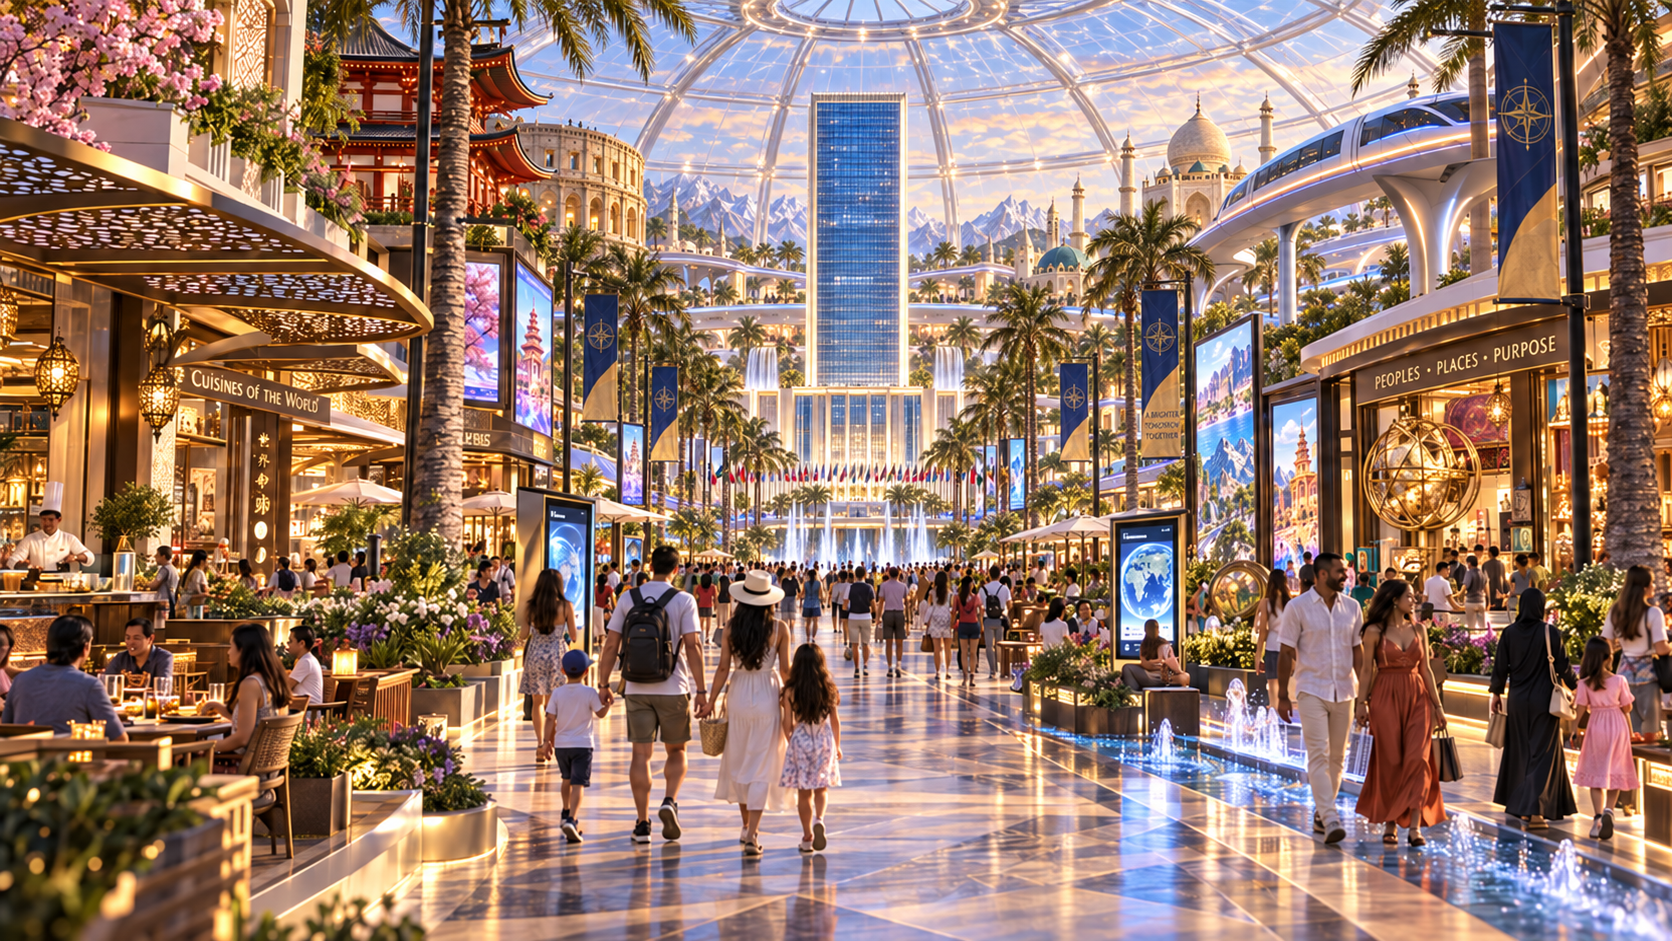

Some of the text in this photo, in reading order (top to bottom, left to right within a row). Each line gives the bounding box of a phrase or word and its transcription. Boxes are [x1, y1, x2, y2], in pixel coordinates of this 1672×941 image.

[1375, 335, 1557, 390] PEOPLES PLACES PURPOSE
